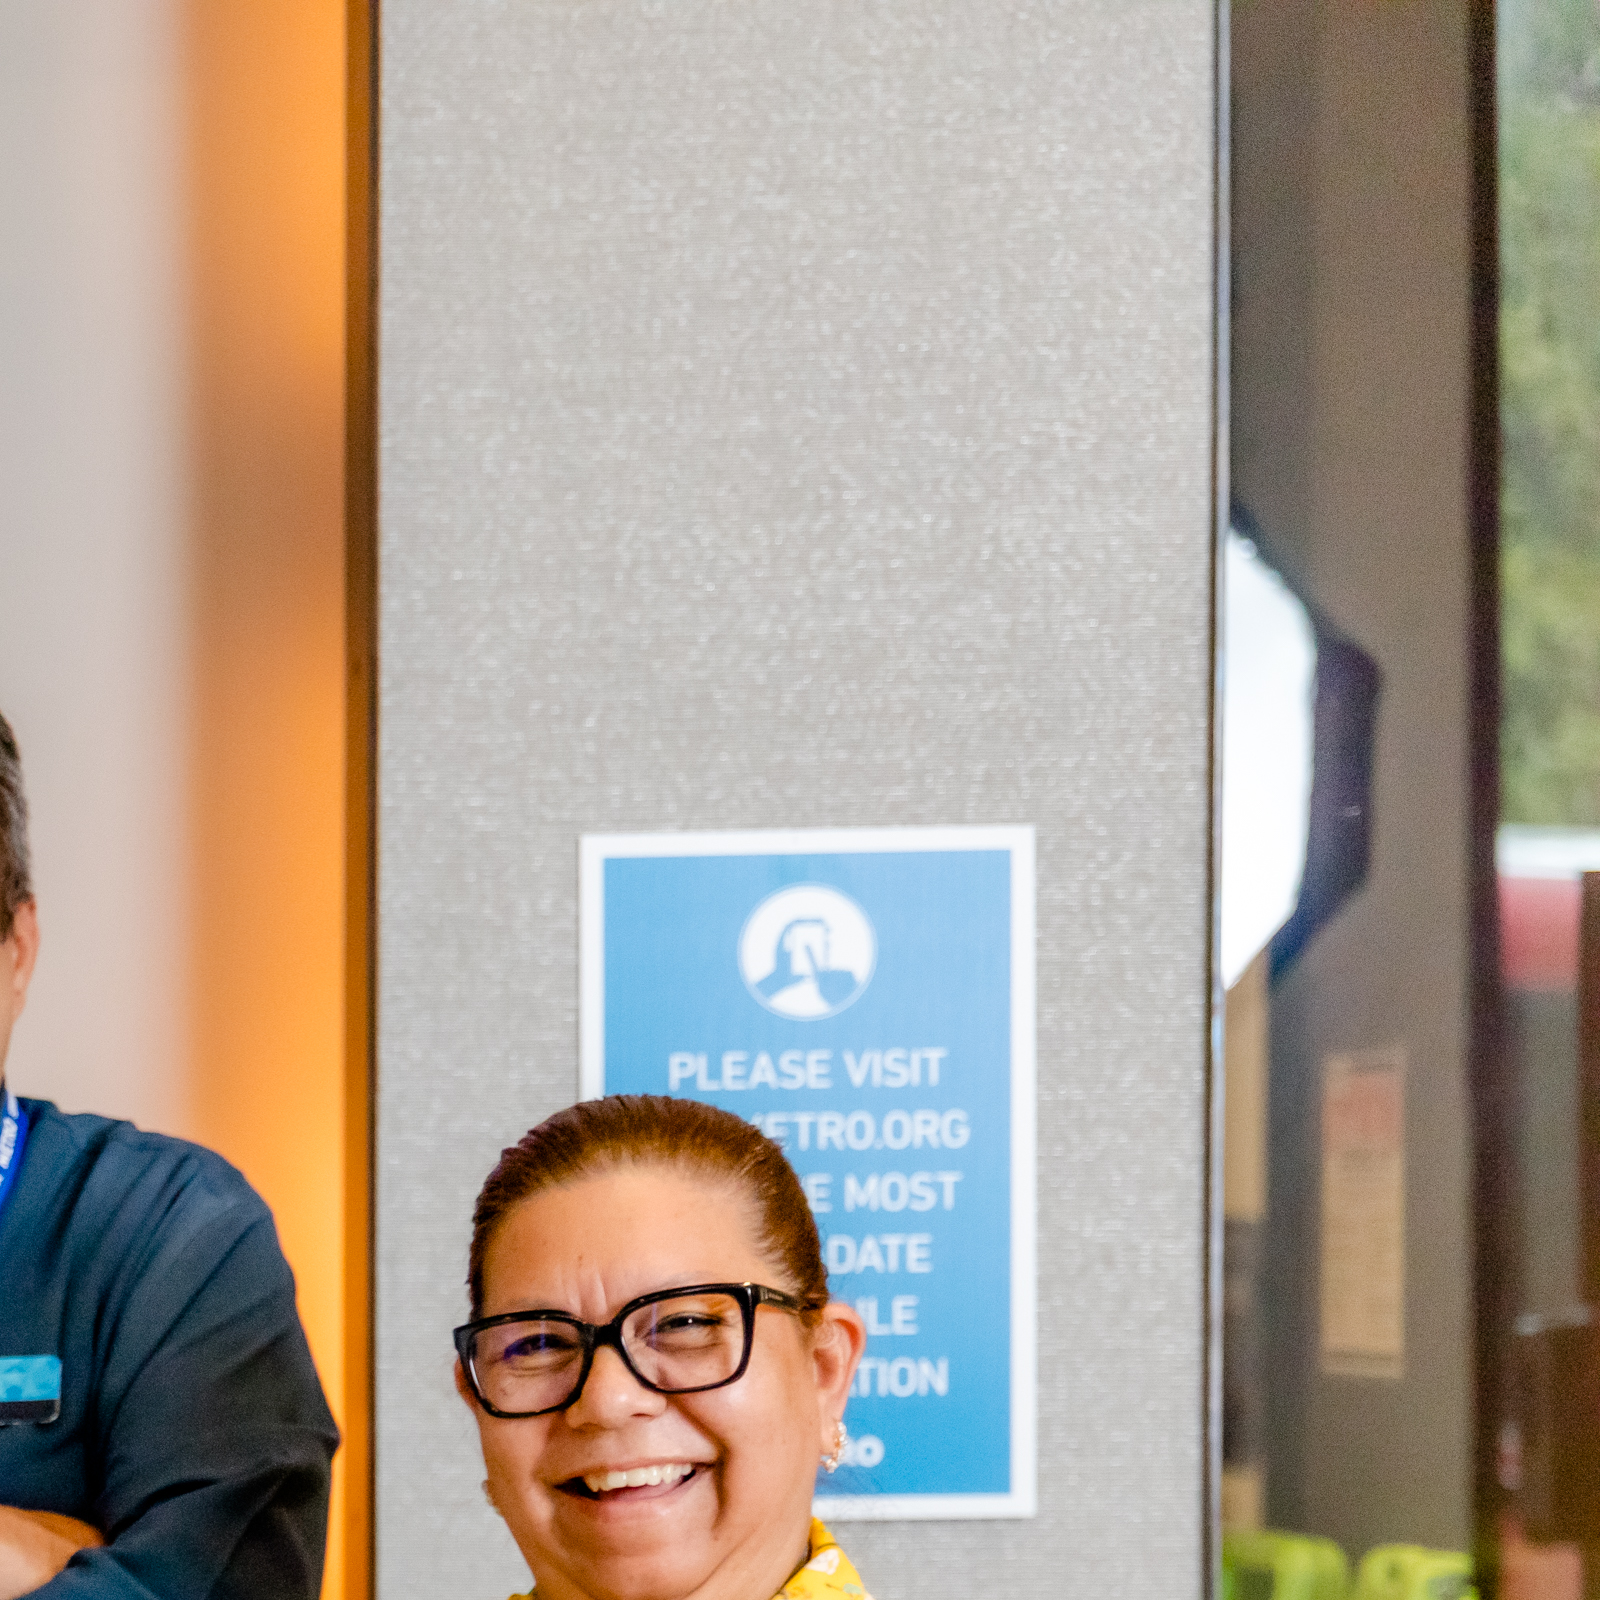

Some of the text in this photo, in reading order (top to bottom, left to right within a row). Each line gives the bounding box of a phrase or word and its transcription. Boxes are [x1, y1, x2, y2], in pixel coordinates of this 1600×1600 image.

[668, 1047, 948, 1092] PLEASE VISIT
[752, 1108, 972, 1151] ETRO.ORG
[844, 1170, 964, 1212] MOST
